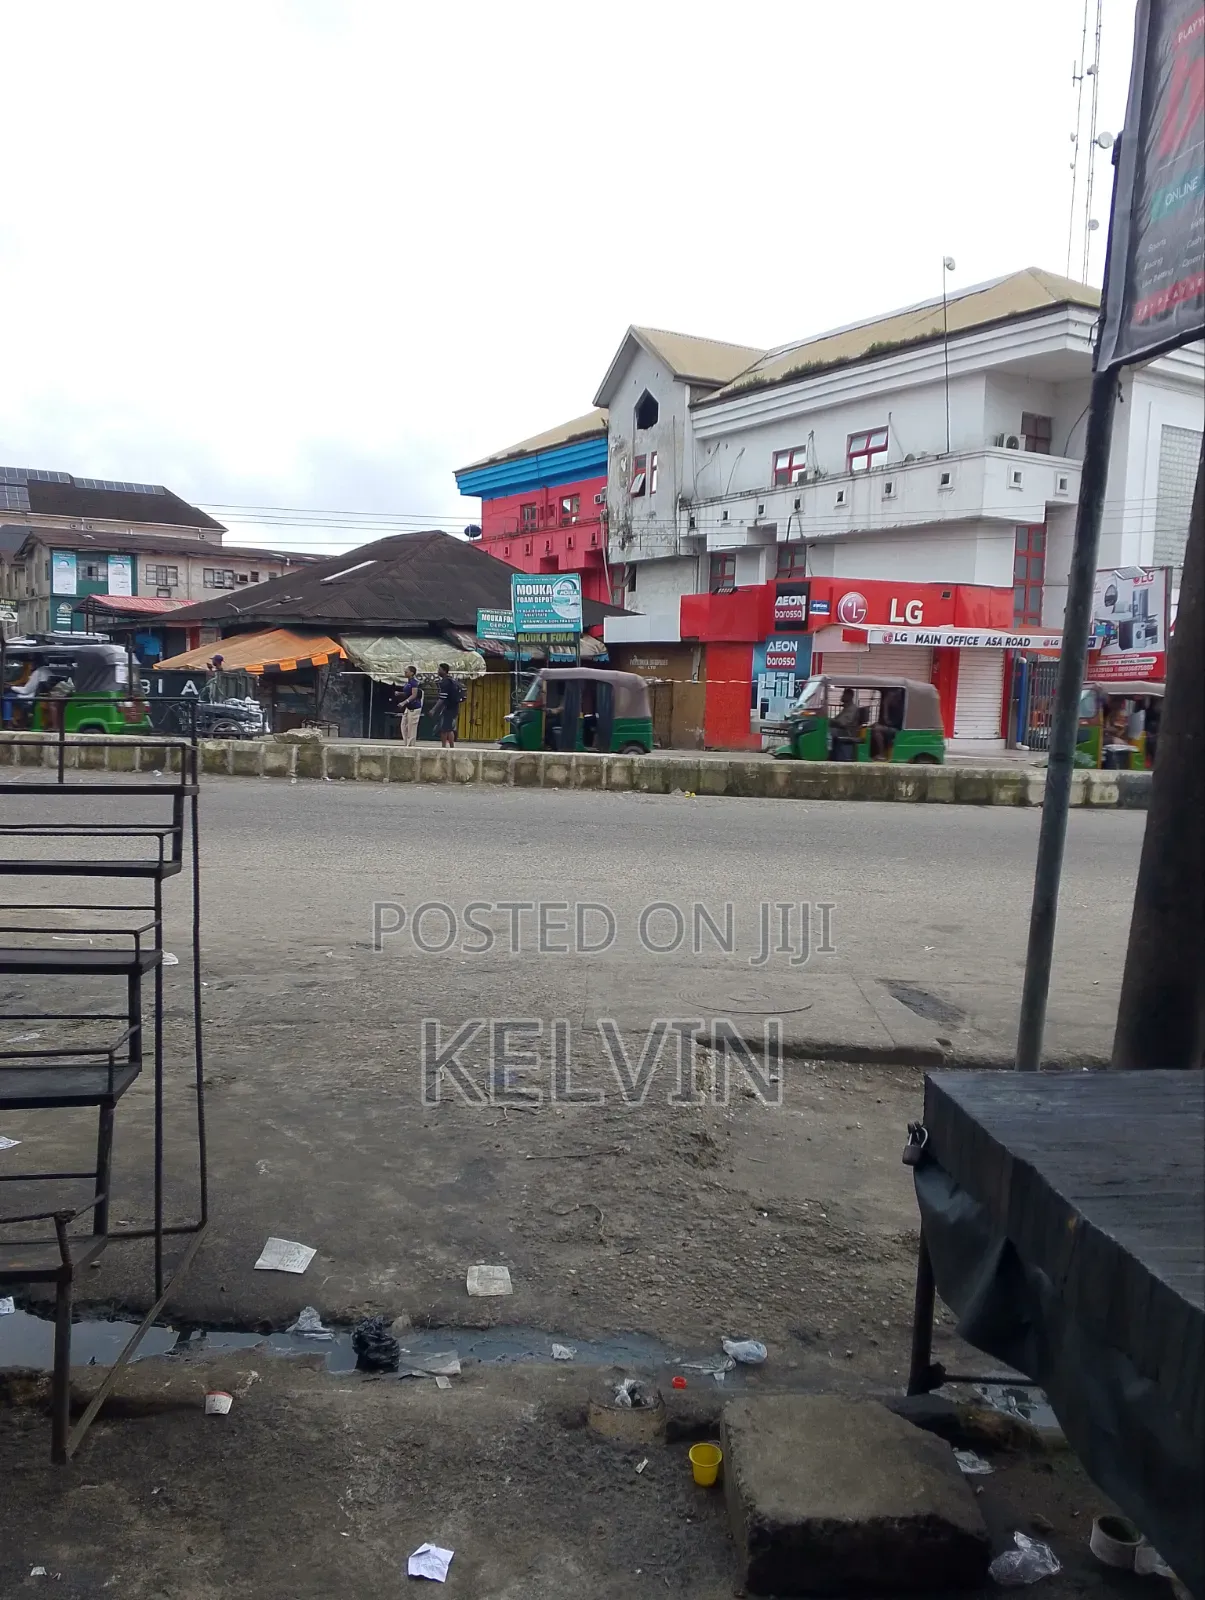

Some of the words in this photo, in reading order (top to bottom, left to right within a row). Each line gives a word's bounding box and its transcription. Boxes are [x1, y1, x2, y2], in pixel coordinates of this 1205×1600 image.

[1165, 176, 1199, 206] ONLINE
[516, 584, 553, 596] MOUKA
[775, 595, 806, 605] AEON
[775, 608, 802, 618] barossa
[890, 598, 924, 625] LG
[481, 614, 502, 622] MOUKA
[518, 633, 547, 643] MOUKA
[550, 633, 574, 642] FOAM
[894, 633, 908, 643] LG
[915, 634, 941, 645] MAIN
[946, 635, 979, 646] OFFICE
[985, 636, 1003, 646] ASA
[1005, 636, 1031, 647] ROAD
[767, 640, 798, 652] AEON
[767, 654, 796, 666] barossa
